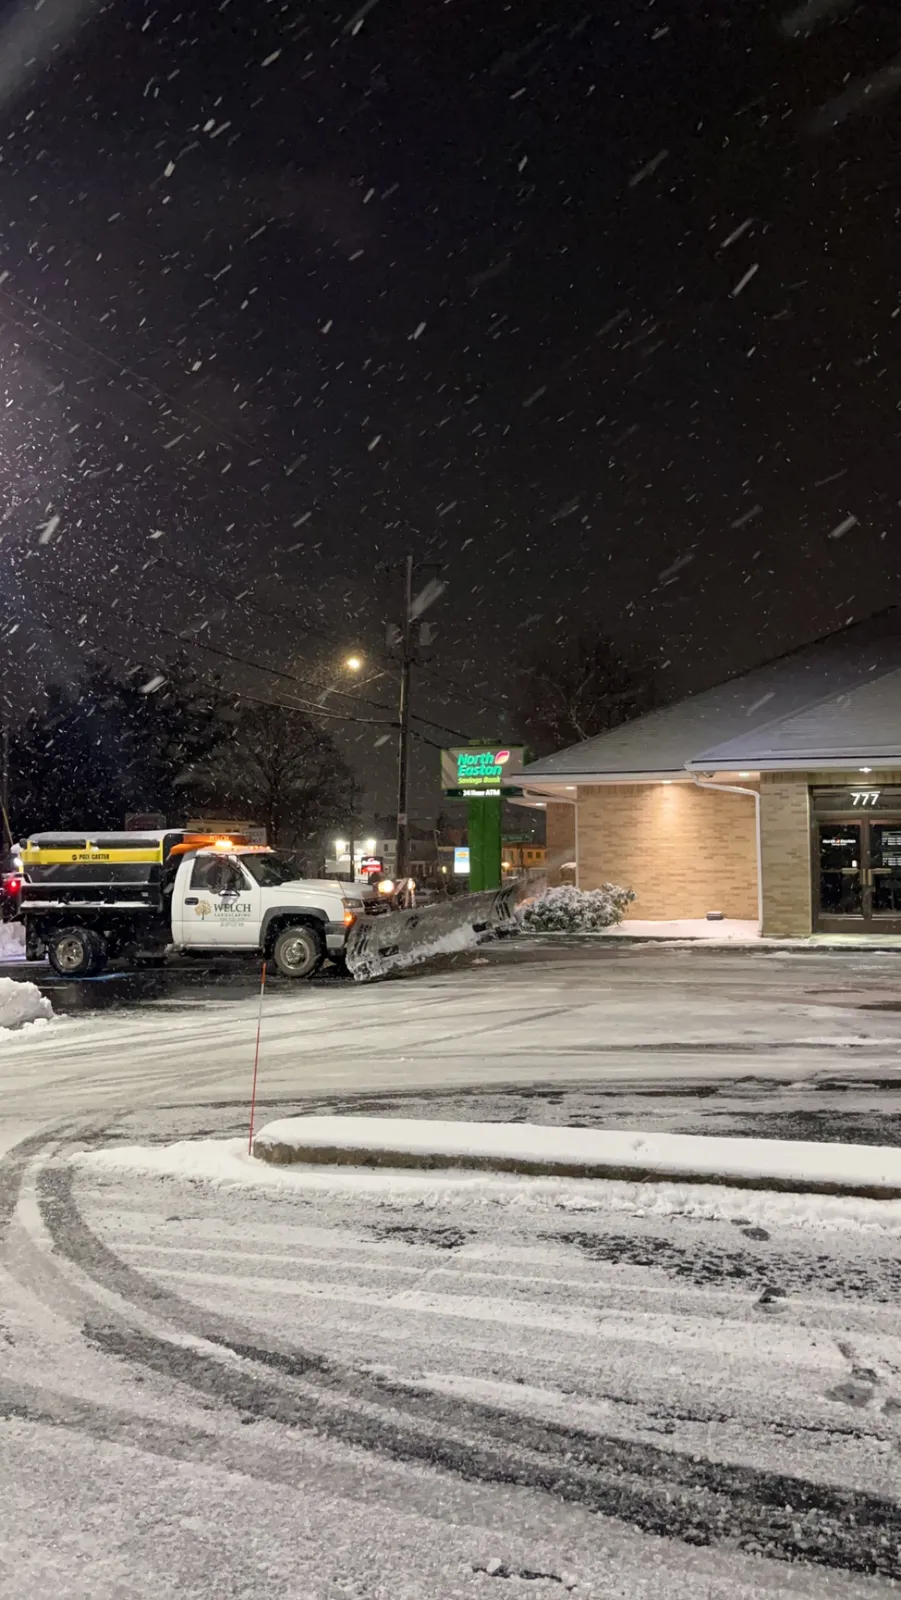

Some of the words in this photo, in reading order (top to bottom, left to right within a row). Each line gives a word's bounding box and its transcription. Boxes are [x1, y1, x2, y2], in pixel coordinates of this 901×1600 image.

[457, 751, 494, 765] North
[457, 764, 502, 776] Easton
[458, 777, 482, 785] Savings
[483, 775, 501, 783] Bank
[485, 788, 501, 796] ATM
[851, 792, 879, 806] 777
[214, 903, 251, 913] WELCH
